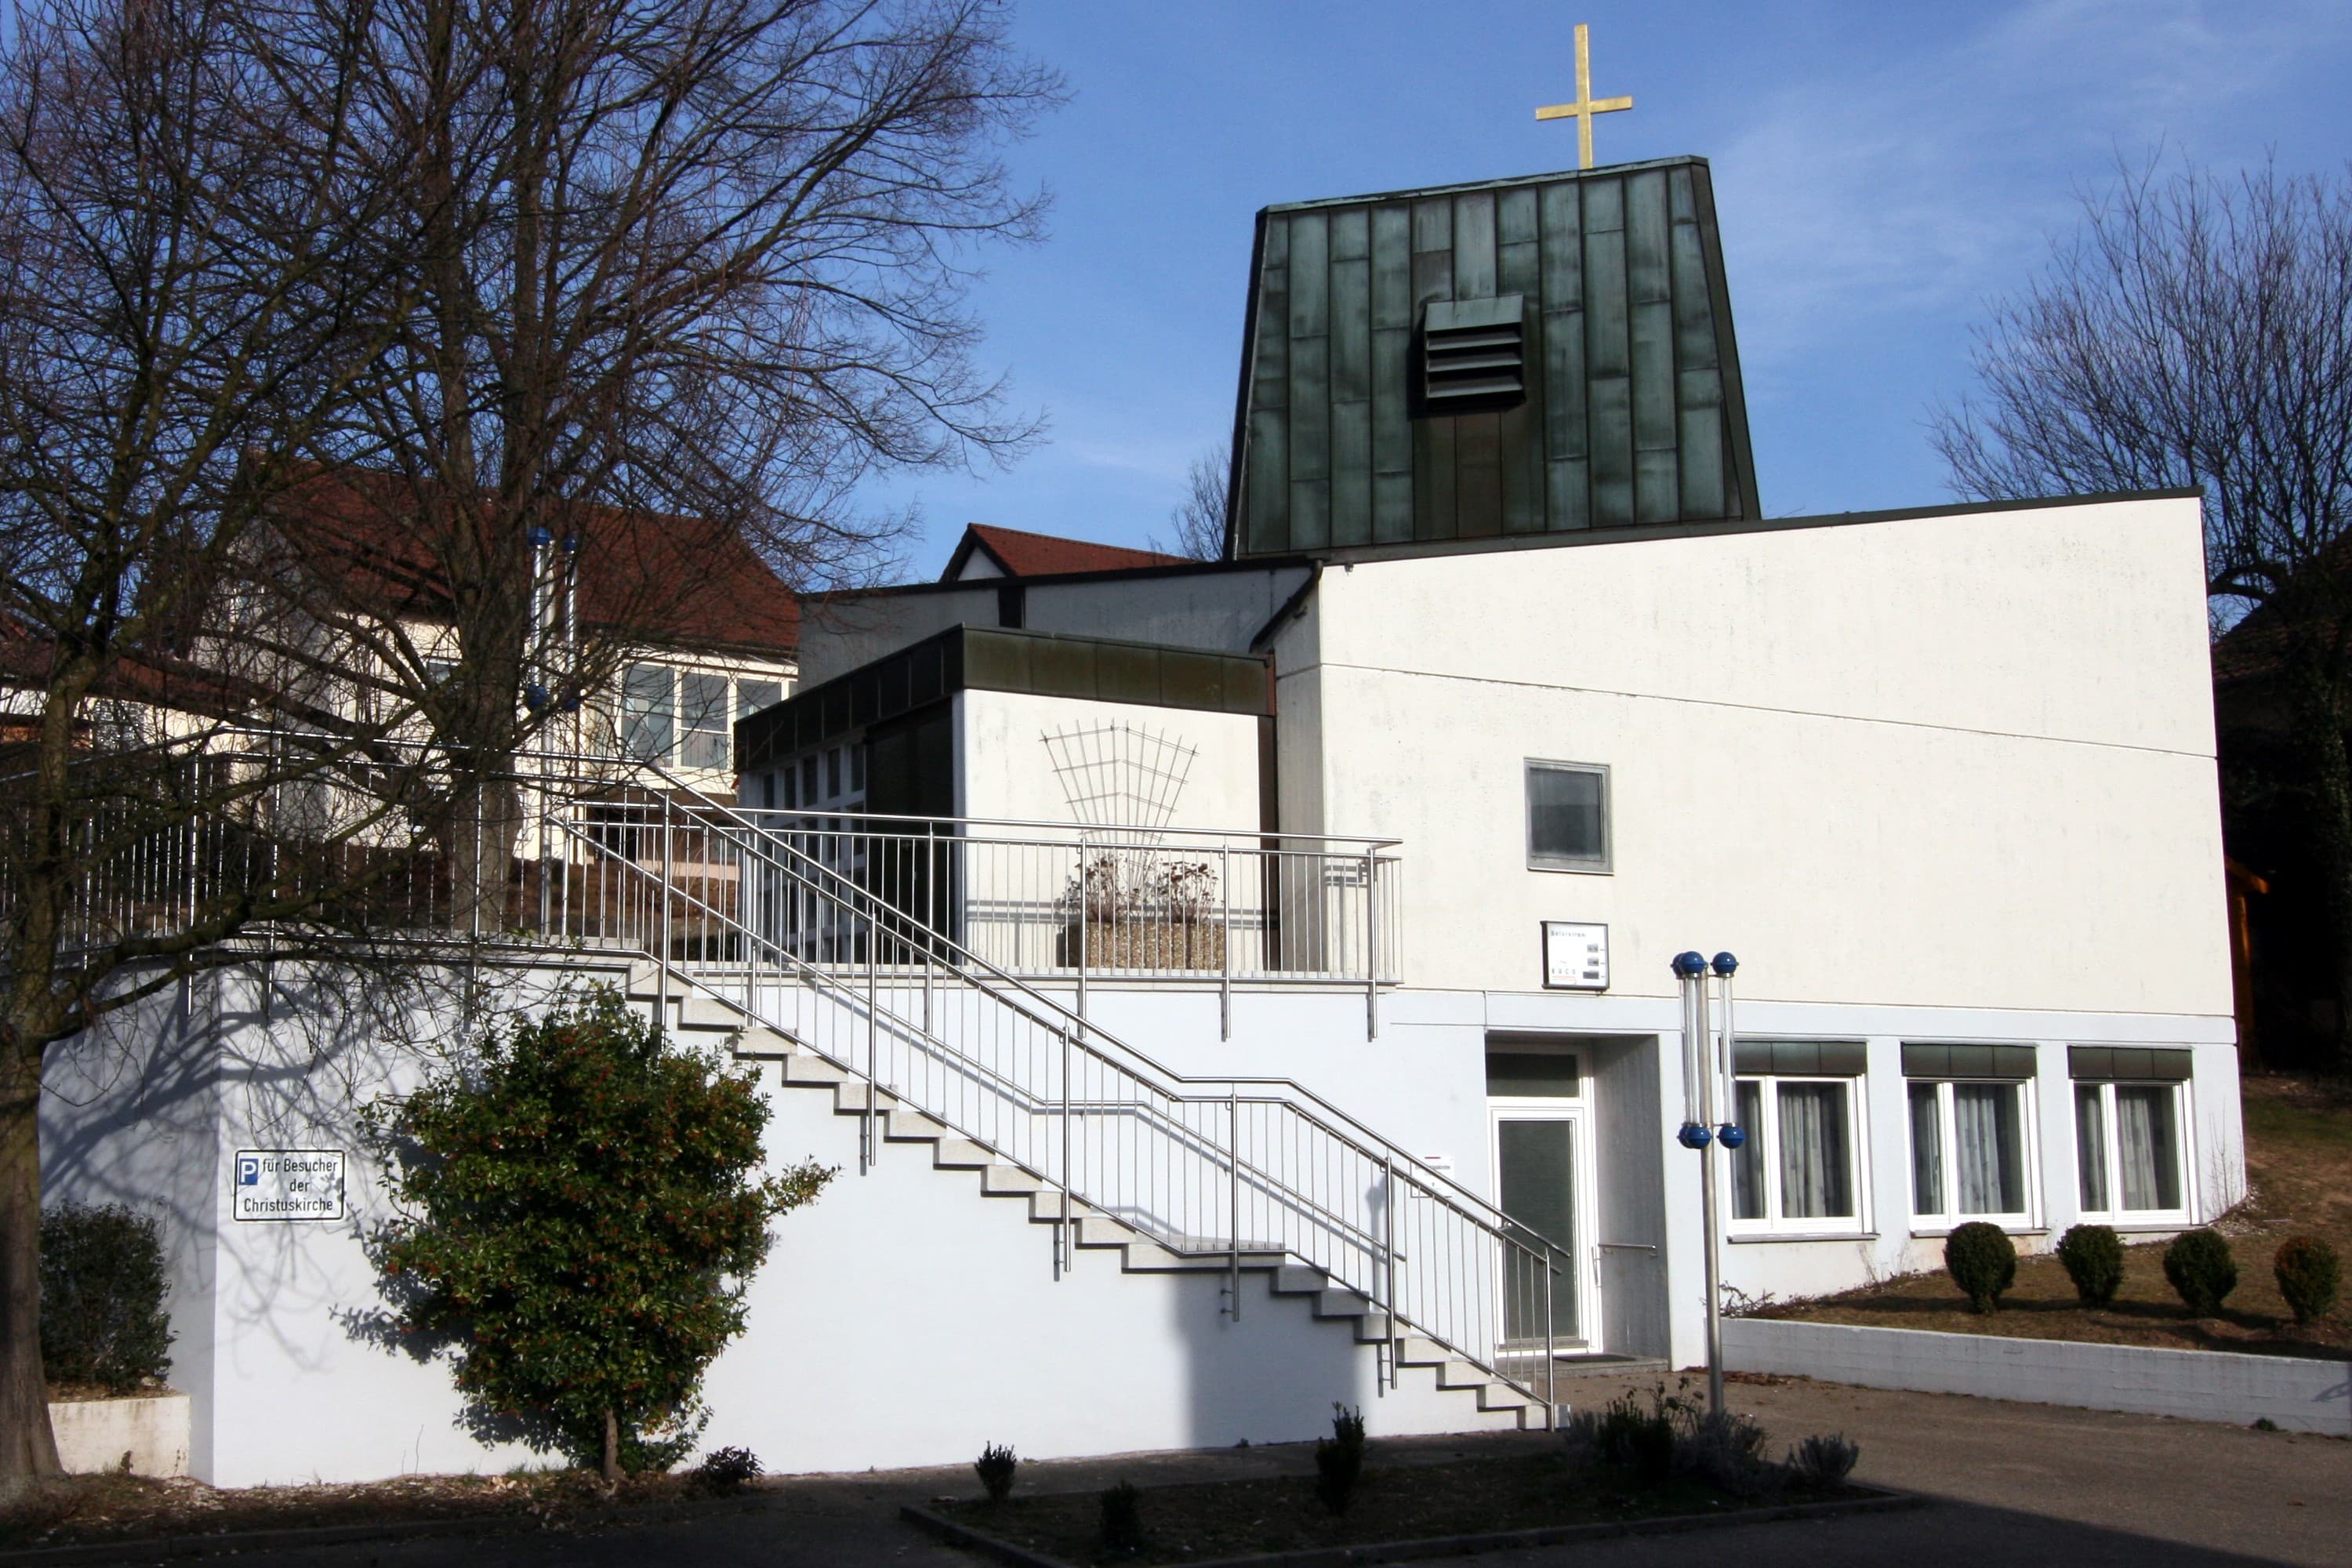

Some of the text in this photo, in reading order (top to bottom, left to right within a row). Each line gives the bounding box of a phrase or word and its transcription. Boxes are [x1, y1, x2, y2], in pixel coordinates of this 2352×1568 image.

[241, 1158, 338, 1183] P für Besucher
[289, 1178, 310, 1192] der
[244, 1197, 333, 1212] Christuskirche
